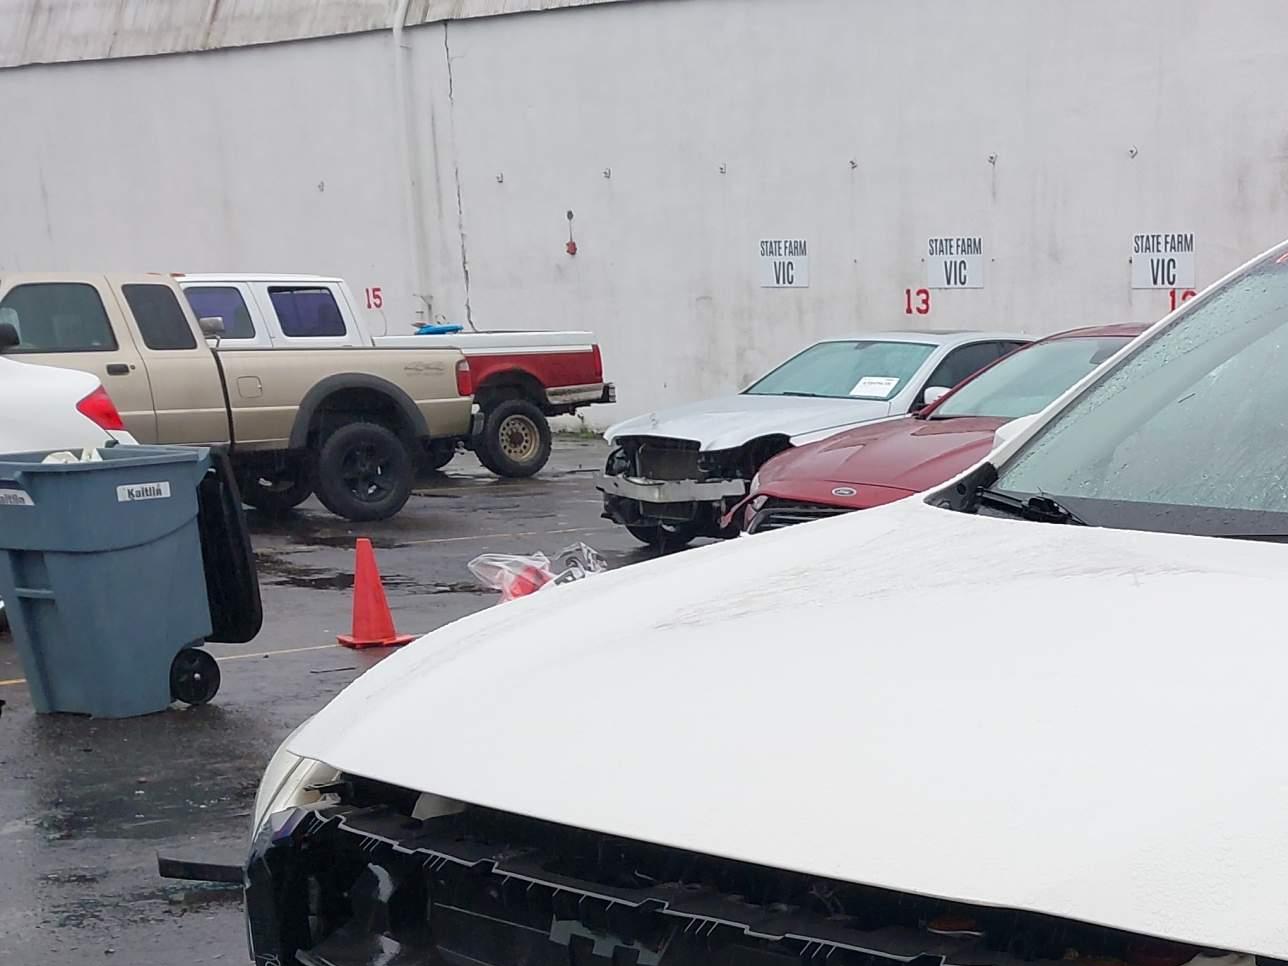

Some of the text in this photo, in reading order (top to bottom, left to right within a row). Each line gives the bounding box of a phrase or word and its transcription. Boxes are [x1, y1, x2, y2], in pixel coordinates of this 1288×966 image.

[760, 240, 807, 257] STATE FARM
[929, 237, 982, 256] STATE FARM
[1134, 233, 1194, 253] STATE FARM
[774, 260, 794, 285] VIC
[944, 260, 967, 286] VIC
[1150, 258, 1176, 286] VIC
[365, 287, 383, 310] 15
[905, 288, 931, 315] 13
[0, 493, 25, 504] aitlin
